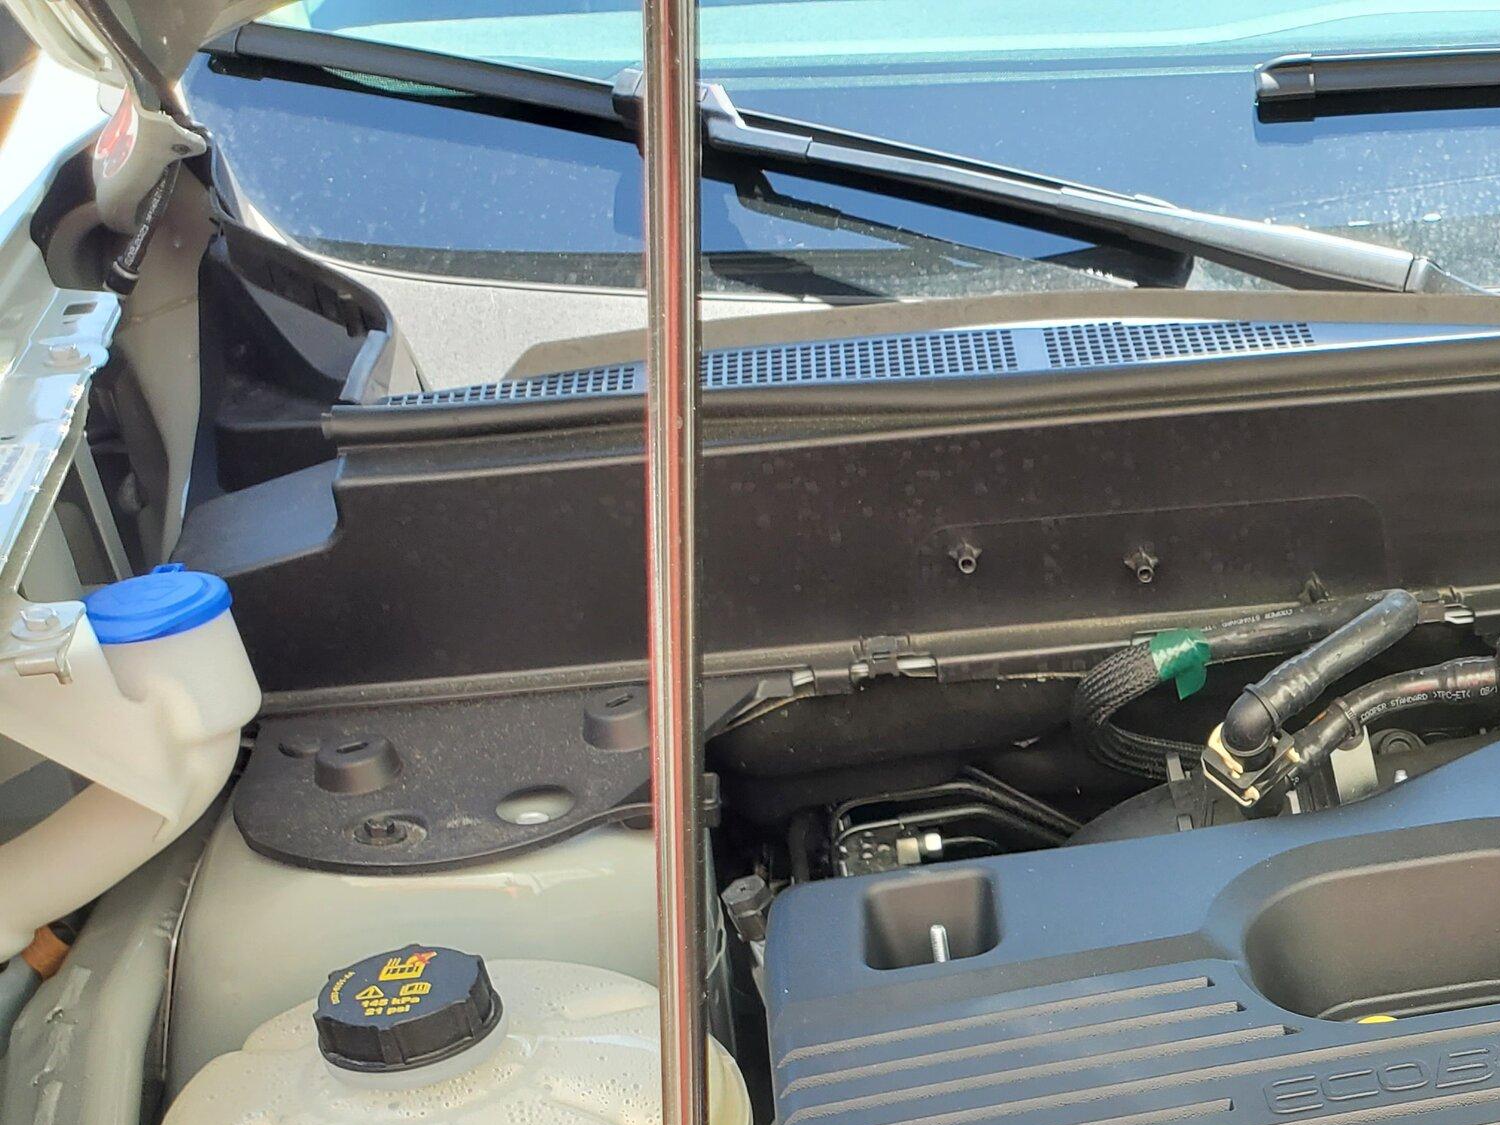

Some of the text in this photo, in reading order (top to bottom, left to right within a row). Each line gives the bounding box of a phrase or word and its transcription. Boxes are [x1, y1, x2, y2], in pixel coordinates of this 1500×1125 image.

[1360, 703, 1388, 722] COOPER
[1389, 692, 1429, 708] STANDARD
[364, 1004, 411, 1017] 21 psi
